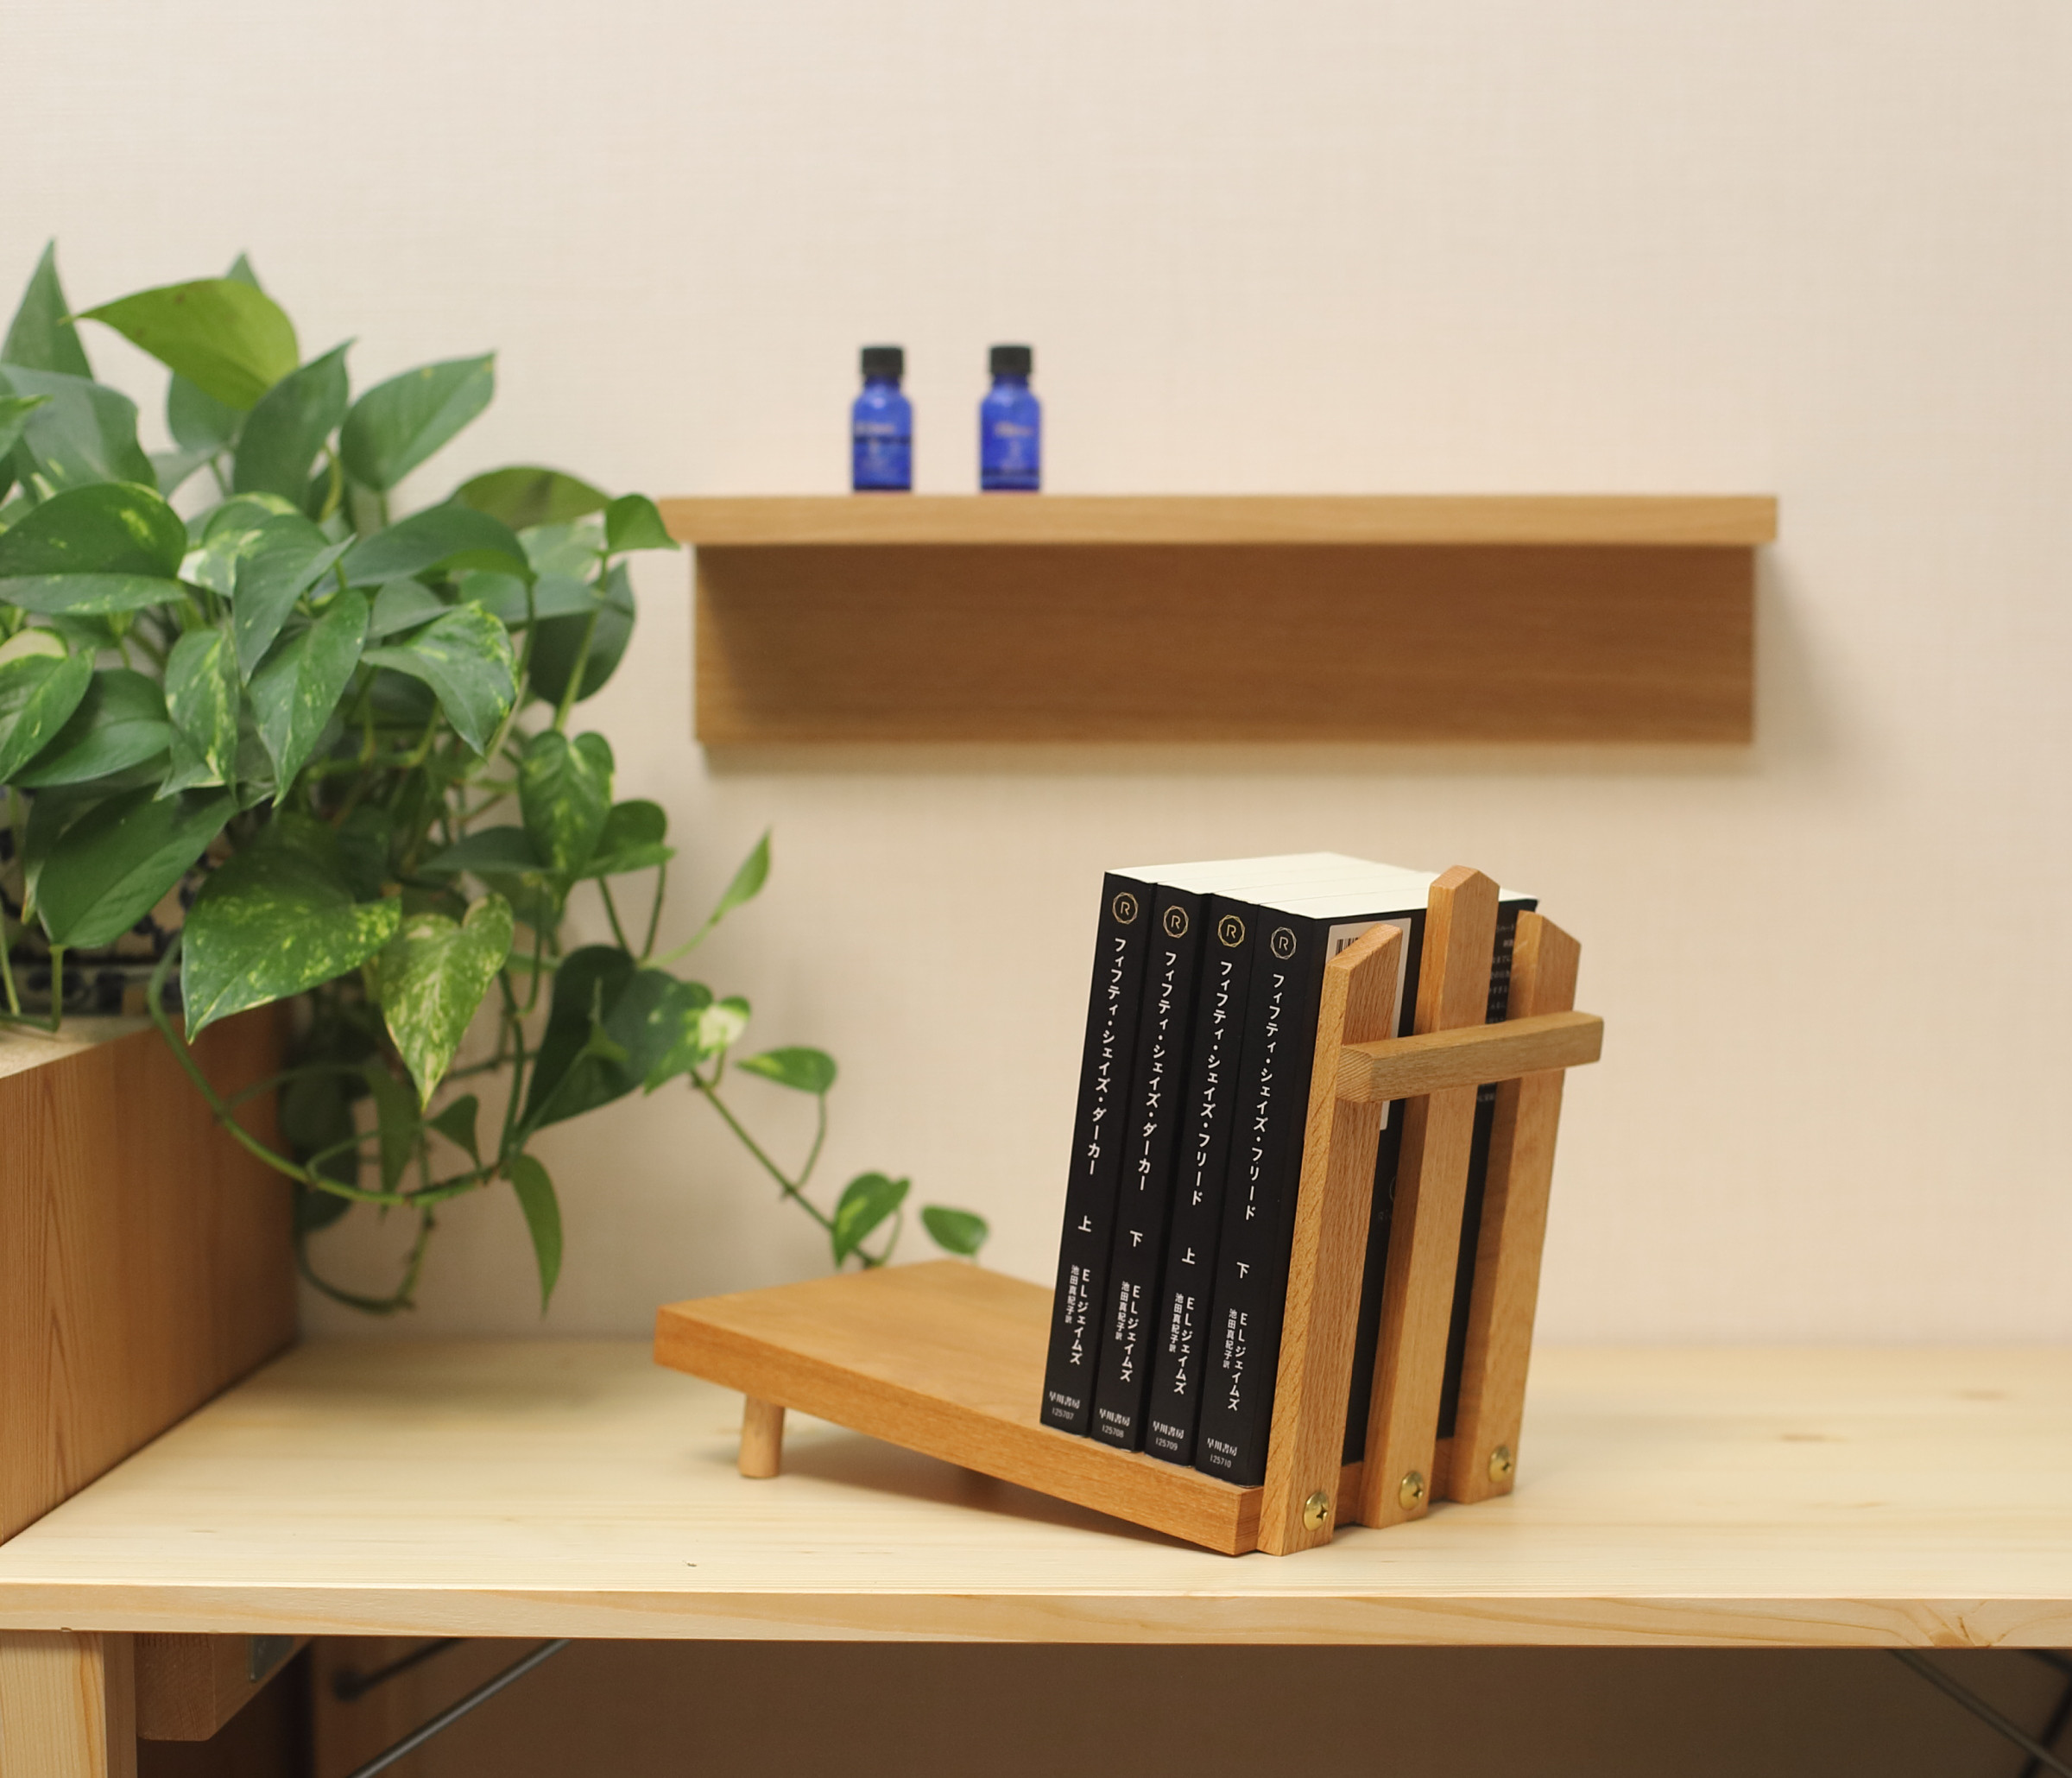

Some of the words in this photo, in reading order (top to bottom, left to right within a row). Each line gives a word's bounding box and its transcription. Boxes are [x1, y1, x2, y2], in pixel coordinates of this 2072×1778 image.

[1087, 937, 1127, 1175] フィフティ・シェイズ・ダーカー
[1138, 951, 1177, 1191] フィフティ・シェイズ・ダーカー
[1192, 960, 1233, 1206] フィフティ・シェイズ・フリード
[1245, 973, 1285, 1221] フィフティ・シェイズ・フリード
[1077, 1215, 1092, 1233] 上
[1129, 1230, 1143, 1248] 下
[1181, 1247, 1196, 1265] 上
[1236, 1262, 1250, 1279] 下
[1052, 1407, 1075, 1420] 125707
[1102, 1424, 1125, 1438] 125708
[1155, 1437, 1178, 1451] 125709
[1210, 1454, 1233, 1468] 125710
